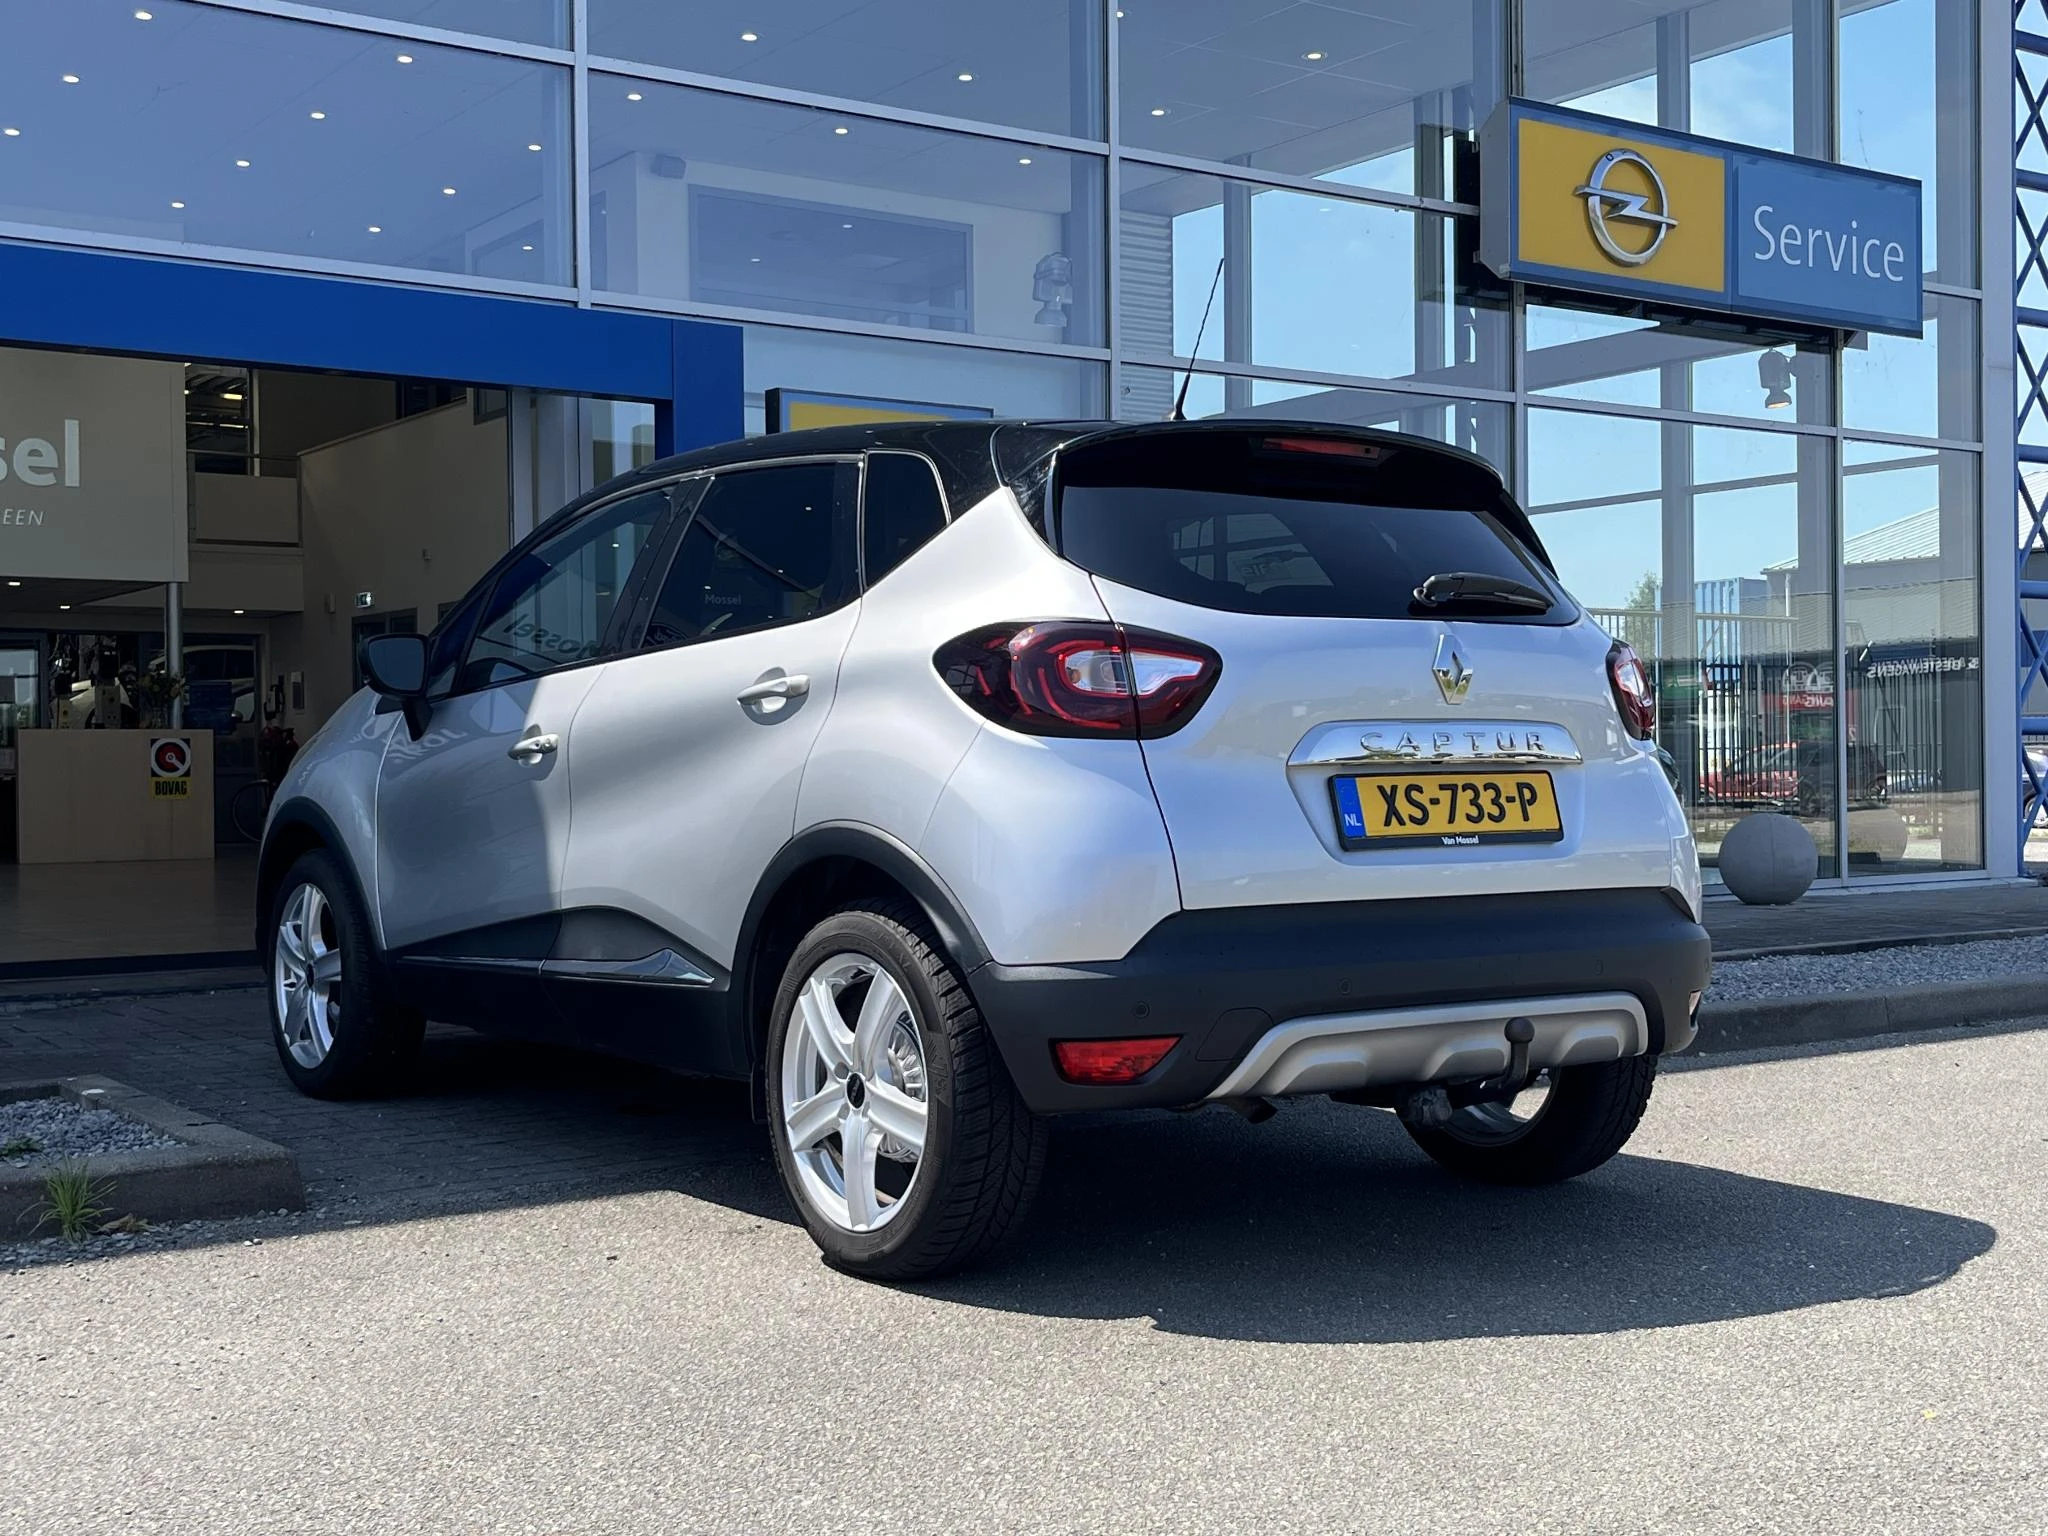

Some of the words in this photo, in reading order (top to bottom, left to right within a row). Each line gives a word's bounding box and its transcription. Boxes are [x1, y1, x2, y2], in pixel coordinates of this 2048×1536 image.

[1754, 205, 1904, 281] Service
[0, 419, 80, 487] el
[1360, 731, 1545, 753] CAPTUR
[155, 781, 187, 796] BOVAG
[1376, 781, 1538, 827] XS-733-P
[1345, 813, 1362, 827] NL
[1441, 836, 1456, 846] Van
